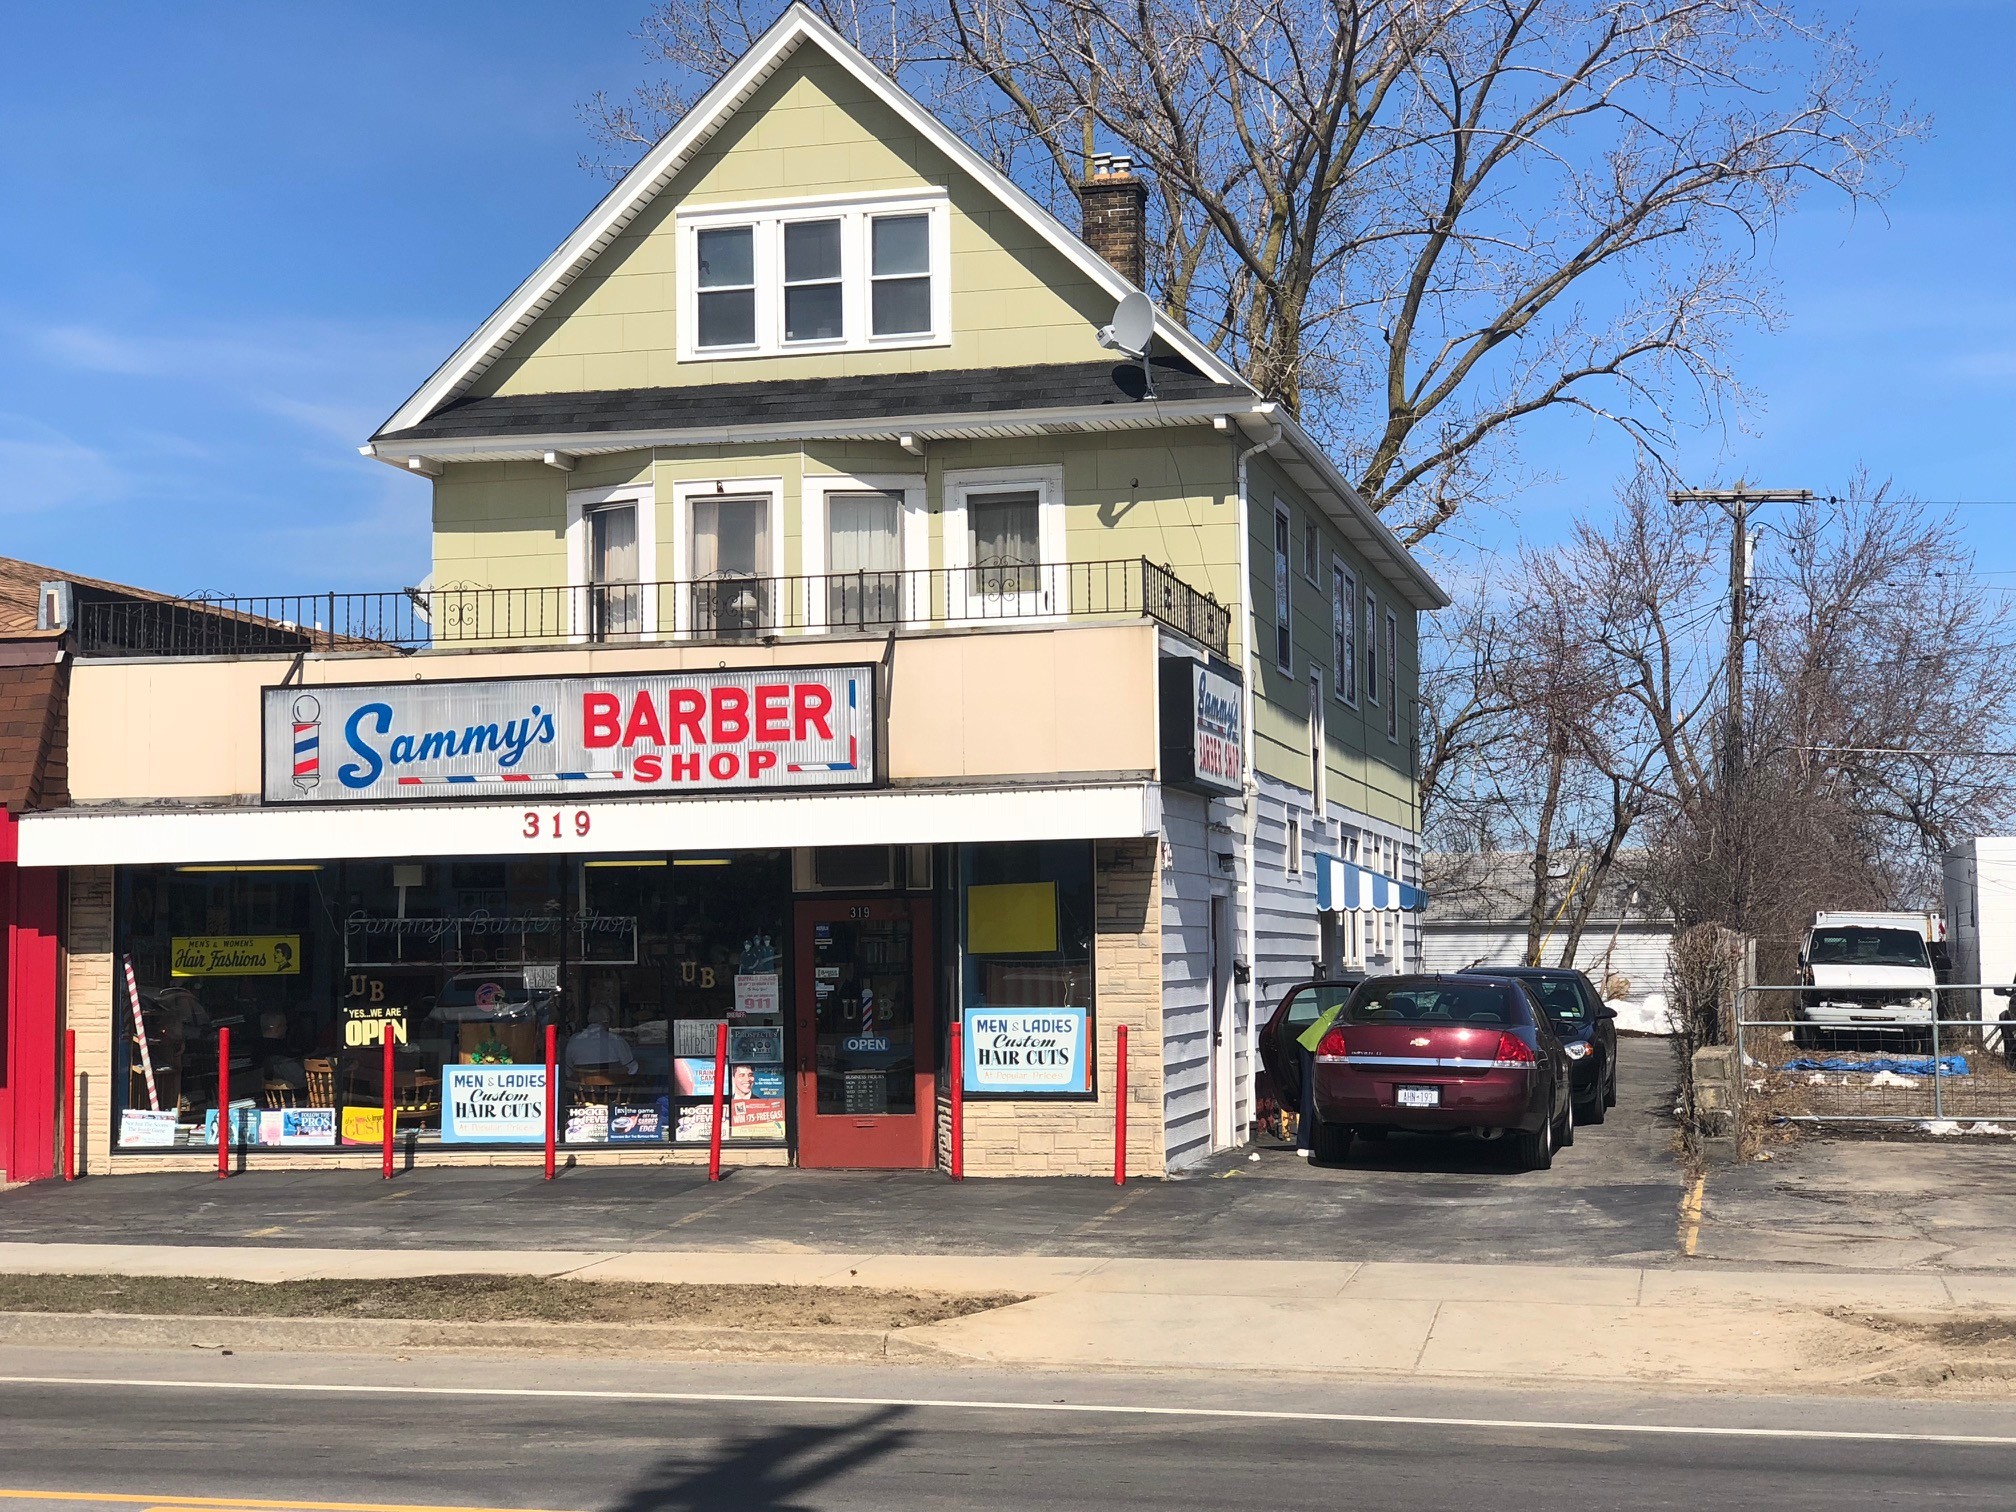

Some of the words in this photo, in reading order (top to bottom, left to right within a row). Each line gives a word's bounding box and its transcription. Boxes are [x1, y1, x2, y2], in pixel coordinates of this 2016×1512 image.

[583, 683, 834, 749] BARBER
[338, 702, 555, 789] Sammy's
[1199, 731, 1222, 777] BARBER
[1225, 742, 1239, 783] SHOP
[633, 750, 777, 783] SHOP
[523, 811, 591, 839] 319
[850, 906, 870, 918] 319
[347, 909, 460, 943] Sammy's
[572, 907, 635, 938] Shop
[188, 940, 210, 948] MEN'S
[223, 939, 254, 947] WOMEN'S
[175, 948, 206, 968] Hair
[205, 949, 267, 971] Fashions
[745, 998, 771, 1009] 911
[385, 1007, 402, 1016] ARE
[678, 1023, 718, 1037] MILITAR
[977, 1019, 1008, 1033] MEN
[1012, 1022, 1019, 1032] &
[1023, 1019, 1072, 1033] LADIES
[847, 1039, 886, 1050] OPEN
[993, 1034, 1057, 1048] Custom
[978, 1048, 1020, 1065] HAIR
[1026, 1047, 1069, 1065] CUTS
[454, 1075, 483, 1087] MEN
[487, 1077, 494, 1087] &
[498, 1075, 546, 1087] LADIES
[997, 1071, 1027, 1080] Popular
[1033, 1071, 1063, 1079] Prices
[470, 1089, 529, 1103] Custom
[455, 1101, 496, 1118] HAIR
[501, 1101, 542, 1118] CUTS
[681, 1107, 725, 1116] HOCKE
[301, 1117, 330, 1127] PROS
